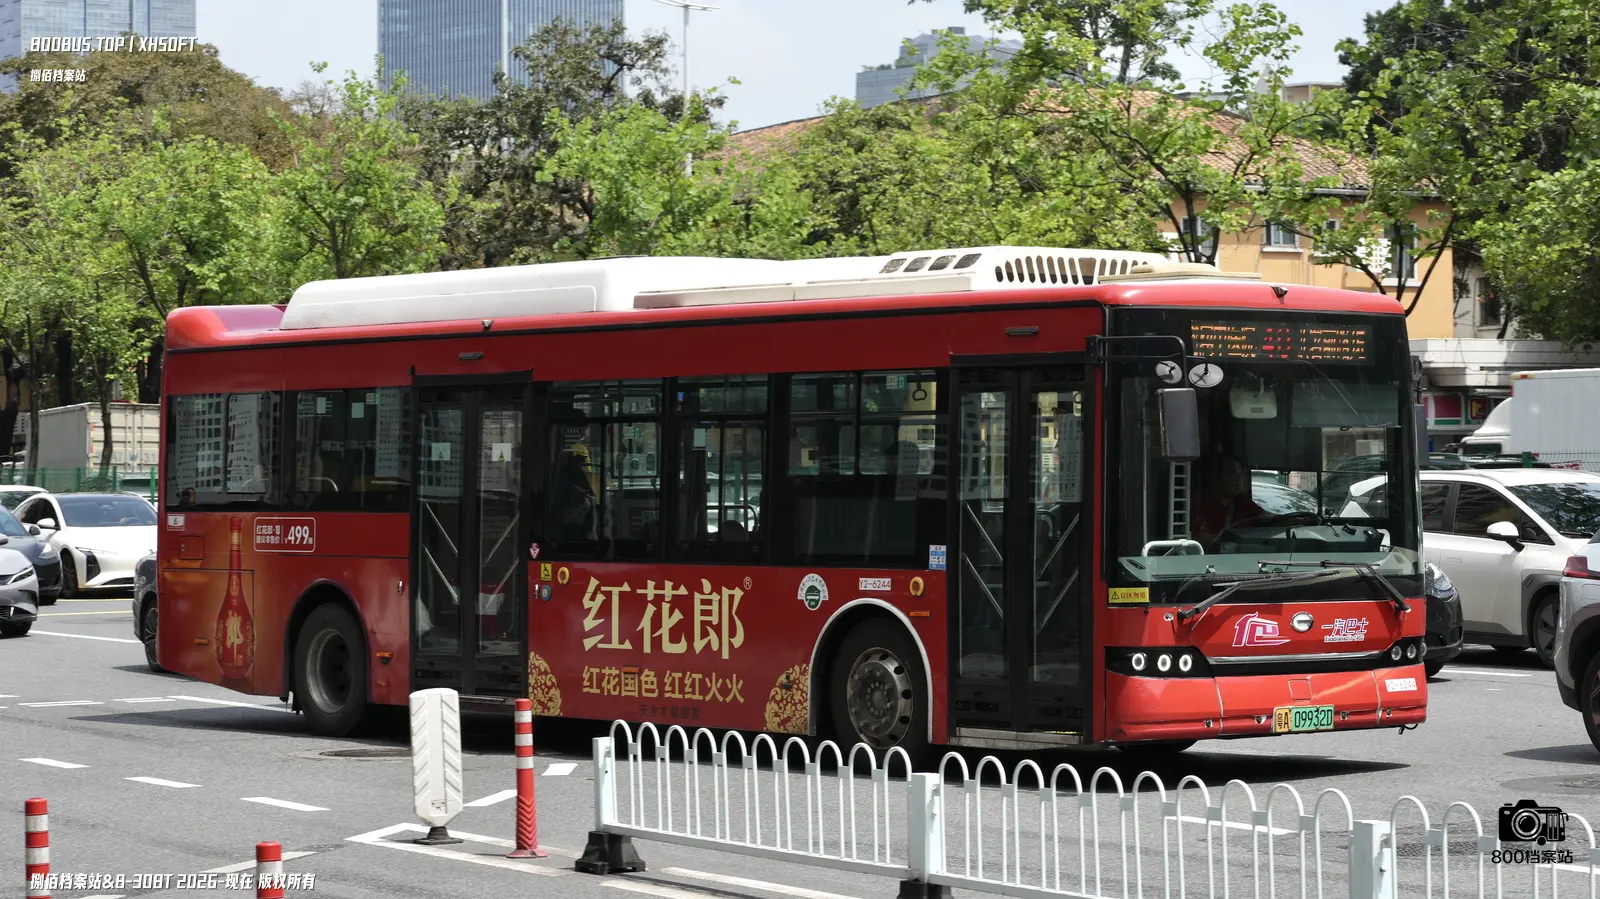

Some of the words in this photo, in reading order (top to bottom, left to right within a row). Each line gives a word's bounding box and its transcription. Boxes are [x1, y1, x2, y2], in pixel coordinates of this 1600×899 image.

[859, 579, 891, 589] Y2-6244
[582, 576, 745, 659] 红花郎
[1321, 617, 1369, 636] 一汽巴士
[582, 666, 659, 698] 红花国色
[664, 670, 745, 703] 红红火火
[1294, 709, 1333, 728] 09932D
